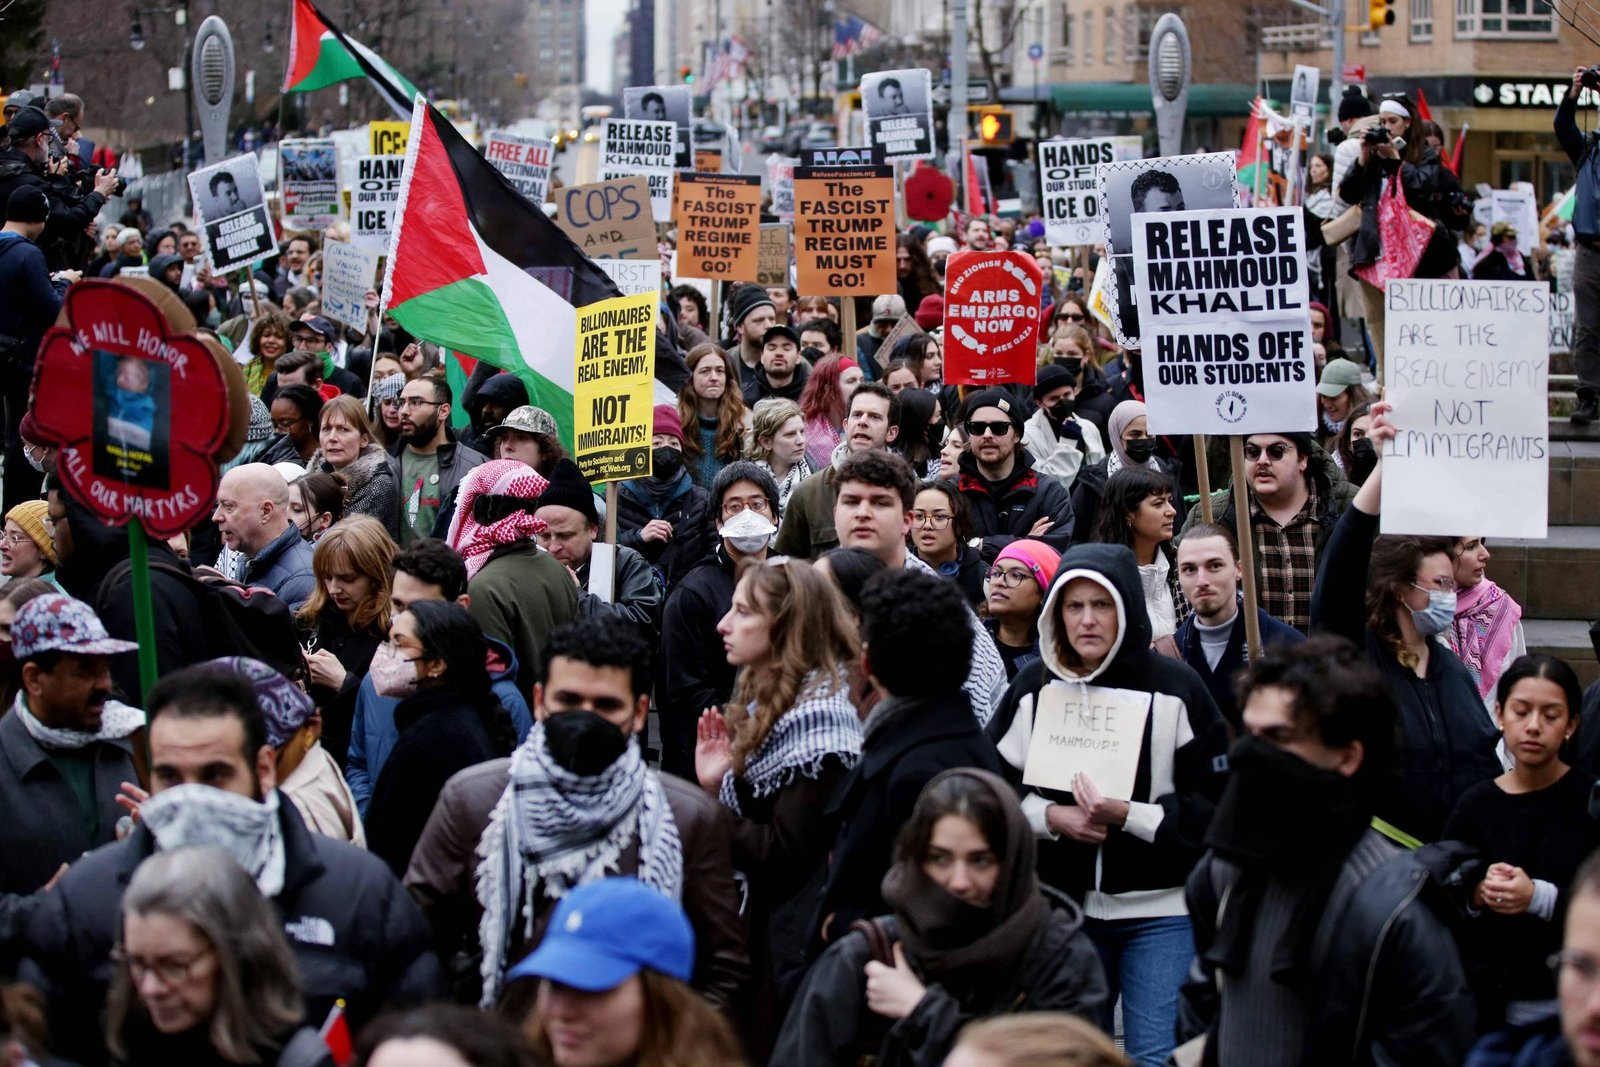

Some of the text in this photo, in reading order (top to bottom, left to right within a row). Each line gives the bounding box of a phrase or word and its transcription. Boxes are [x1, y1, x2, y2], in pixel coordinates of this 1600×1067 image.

[608, 123, 672, 142] RELEASE
[489, 141, 548, 167] FREE ALL
[606, 141, 671, 156] MAHMOUD
[1044, 142, 1113, 168] HANDS
[360, 160, 405, 179] HAN
[489, 160, 547, 179] ALESTINIAN
[605, 155, 671, 167] KHALIL
[1047, 166, 1097, 180] OF
[360, 181, 401, 190] OF
[704, 186, 735, 199] The
[825, 182, 863, 196] The
[1046, 180, 1097, 192] OUR STUDE
[358, 192, 399, 202] OUR STU
[565, 184, 640, 228] COPS
[683, 200, 756, 214] FASCIST
[800, 200, 890, 214] FASCIST
[1048, 195, 1100, 219] ICE O
[219, 212, 256, 235] RELEASE
[358, 210, 386, 230] ICE
[688, 216, 749, 228] TRUMP
[807, 218, 882, 233] TRUMP
[216, 222, 264, 250] MAHMOUD
[584, 230, 623, 247] AND
[685, 231, 751, 244] REGIME
[760, 229, 782, 245] EE
[805, 236, 887, 251] REGIME
[1146, 214, 1297, 260] RELEASE
[692, 245, 742, 258] MUST
[702, 261, 732, 273] GO!
[816, 255, 876, 269] MUST
[757, 272, 784, 283] OW
[828, 273, 864, 287] GO!
[950, 260, 1001, 295] END ZIONISM
[1148, 256, 1298, 292] MAHMOUD
[969, 290, 1020, 303] ARMS
[1150, 288, 1301, 314] KHALIL
[1389, 282, 1546, 314] BILLIONAIRES
[1550, 293, 1569, 312] ND
[580, 304, 650, 334] BILLIONAIRES
[948, 304, 1038, 319] EMBARGO
[974, 319, 1014, 333] NOW
[1398, 324, 1498, 346] ARE THE
[581, 326, 647, 362] ARE THE
[992, 326, 1033, 354] FREE GAZA
[1157, 331, 1304, 362] HANDS OFF
[69, 321, 188, 379] WE WILL HONOR
[578, 355, 648, 384] REAL ENEMY,
[1158, 362, 1306, 385] OUR STUDENTS
[1393, 356, 1547, 389] REAL ENEMY
[592, 394, 630, 427] NOT
[1434, 399, 1493, 426] NOT
[578, 424, 646, 451] IMMIGRANTS!
[1384, 429, 1545, 462] IMMIGRANTS
[579, 461, 587, 469] Party
[593, 456, 613, 465] Socialism
[614, 454, 625, 462] and
[62, 448, 86, 486] ALL
[90, 480, 119, 512] OUR
[124, 484, 199, 519] MARTYRS
[1064, 703, 1117, 732] FREE
[1049, 734, 1110, 750] MAHMOUD
